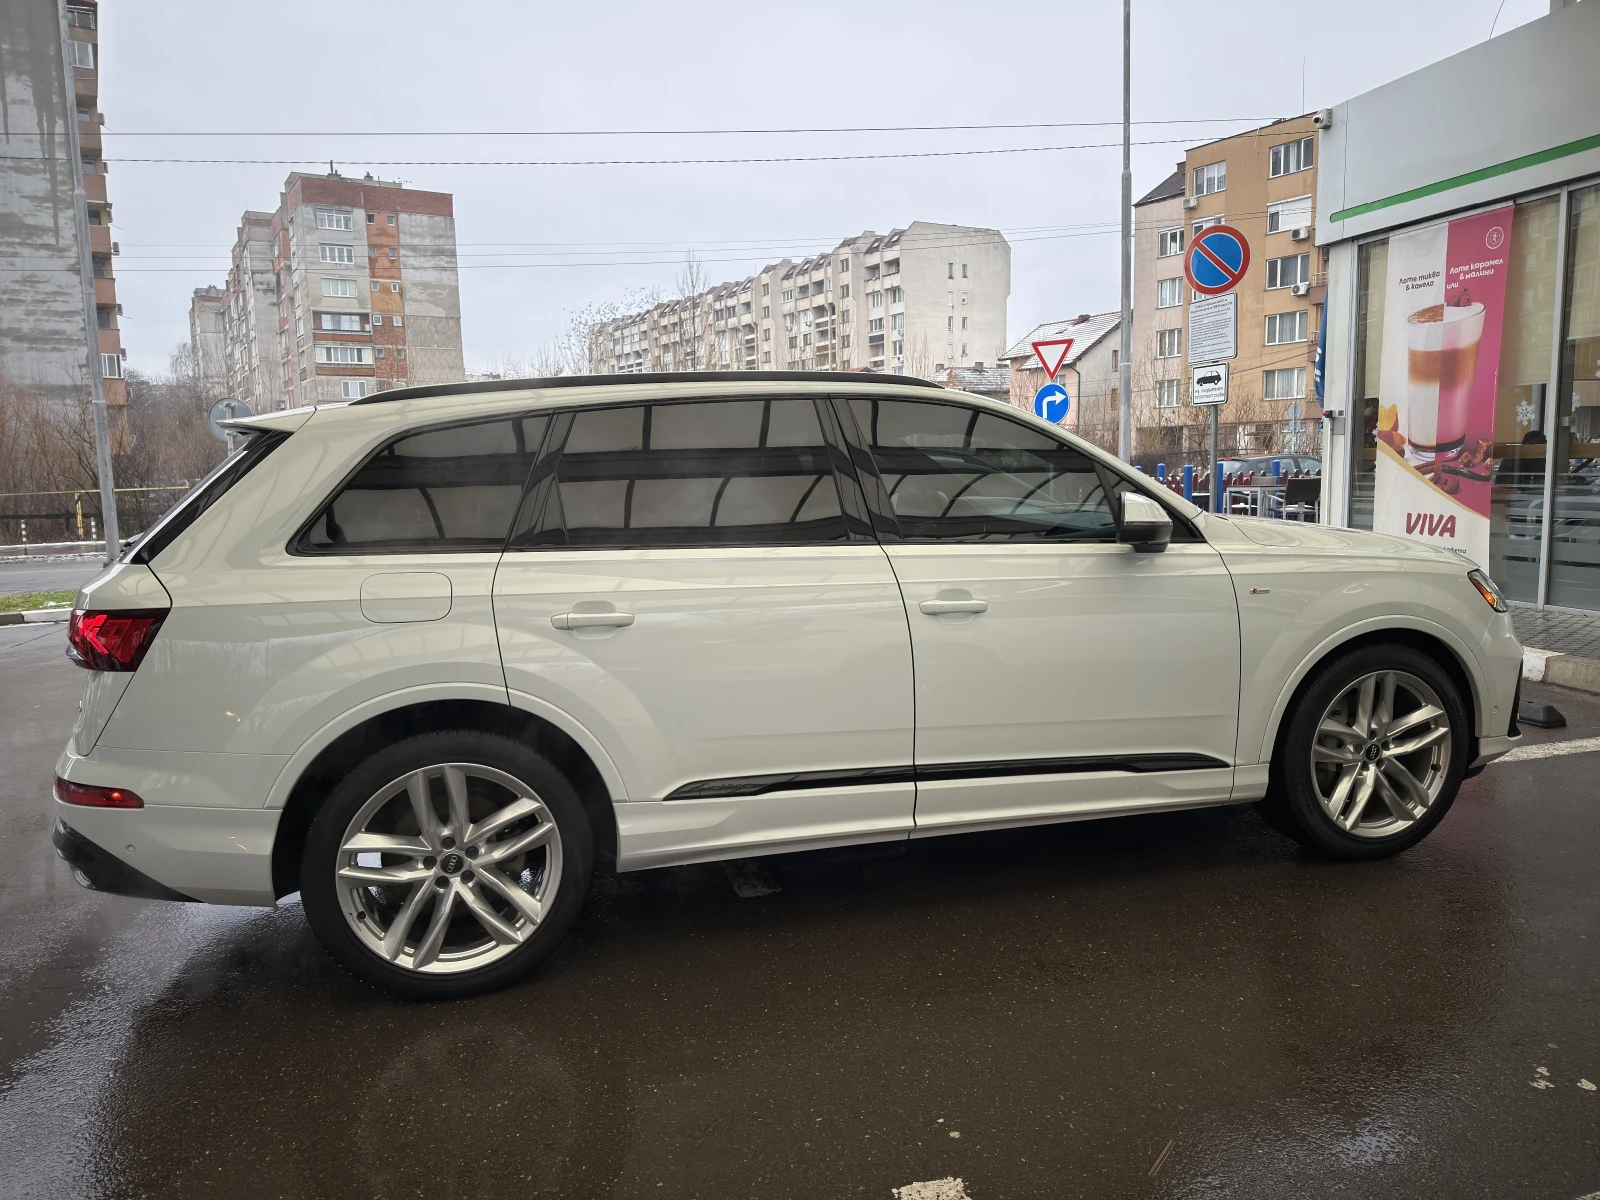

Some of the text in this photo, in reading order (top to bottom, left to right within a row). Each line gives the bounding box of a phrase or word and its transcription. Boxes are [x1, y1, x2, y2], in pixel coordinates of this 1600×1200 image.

[1470, 259, 1504, 270] карамел
[1465, 269, 1494, 280] малини
[1411, 281, 1434, 290] канела
[1405, 512, 1456, 538] VIVA
